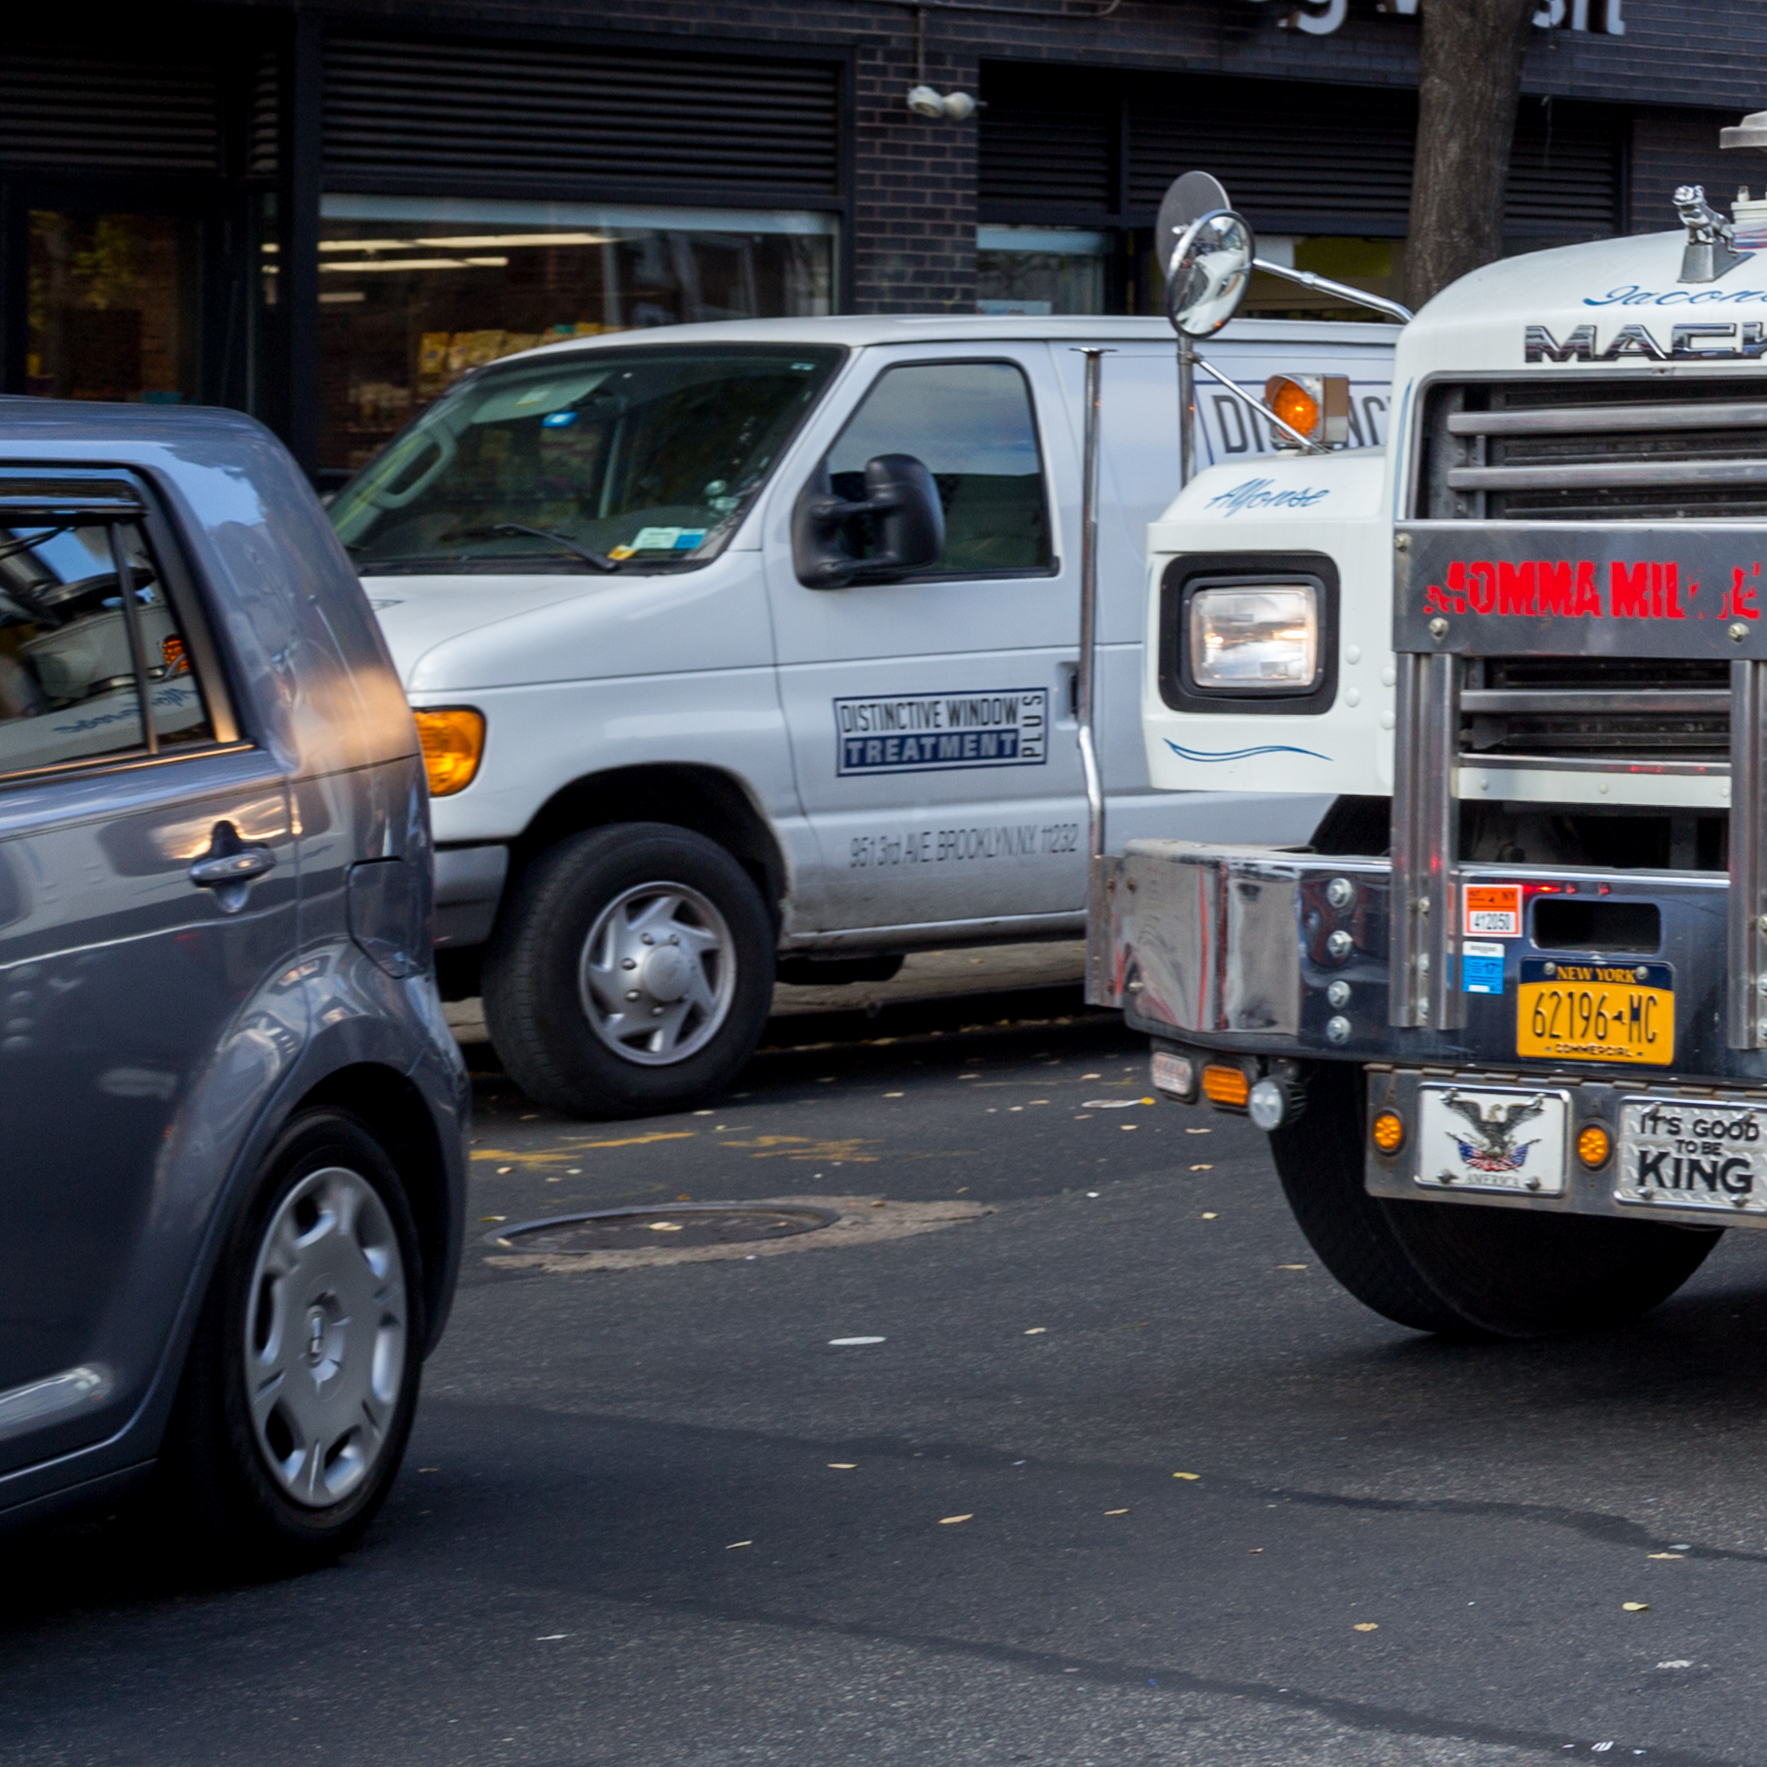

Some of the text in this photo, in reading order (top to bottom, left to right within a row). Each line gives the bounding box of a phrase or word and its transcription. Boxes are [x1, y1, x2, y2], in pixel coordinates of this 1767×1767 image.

[839, 696, 1020, 734] DISTINCTIVE WINDOW
[1020, 694, 1043, 759] PLUS
[847, 732, 1017, 765] TREATMENT
[1556, 965, 1638, 984] NEW YORK
[1555, 1042, 1634, 1058] COMMERCIAL
[1639, 1112, 1760, 1142] IT'S GOOD
[1676, 1137, 1723, 1156] TO BE
[1465, 1172, 1521, 1189] AMERICA
[1636, 1147, 1755, 1195] KING
